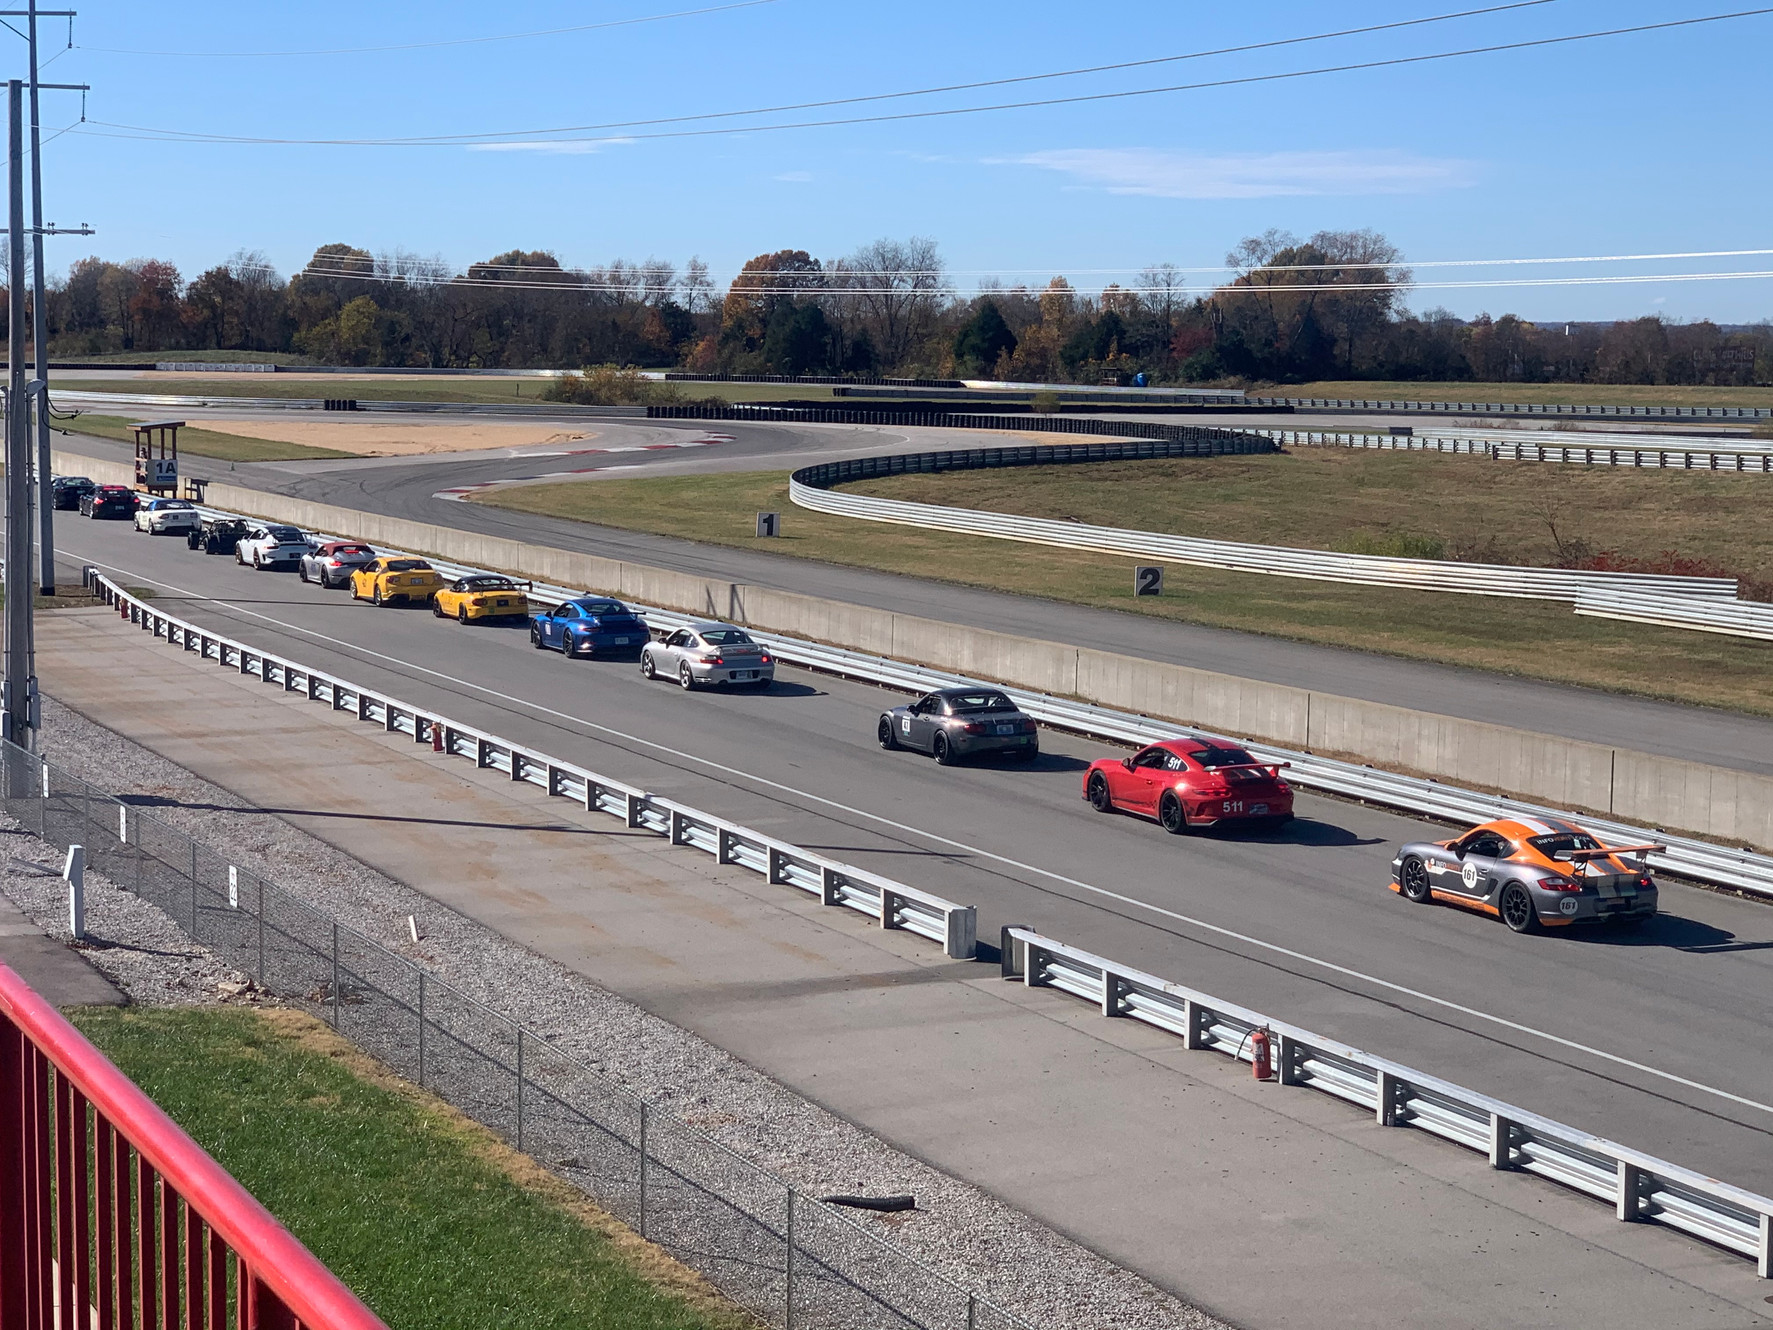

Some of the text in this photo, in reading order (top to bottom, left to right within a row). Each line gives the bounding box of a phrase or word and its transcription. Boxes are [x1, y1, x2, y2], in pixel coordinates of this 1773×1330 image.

[156, 462, 176, 473] 1A
[762, 513, 774, 536] 1
[1138, 567, 1160, 595] 2
[1167, 756, 1182, 770] 511
[1222, 800, 1243, 812] 511
[1463, 868, 1475, 881] 161
[1561, 902, 1576, 911] 161
